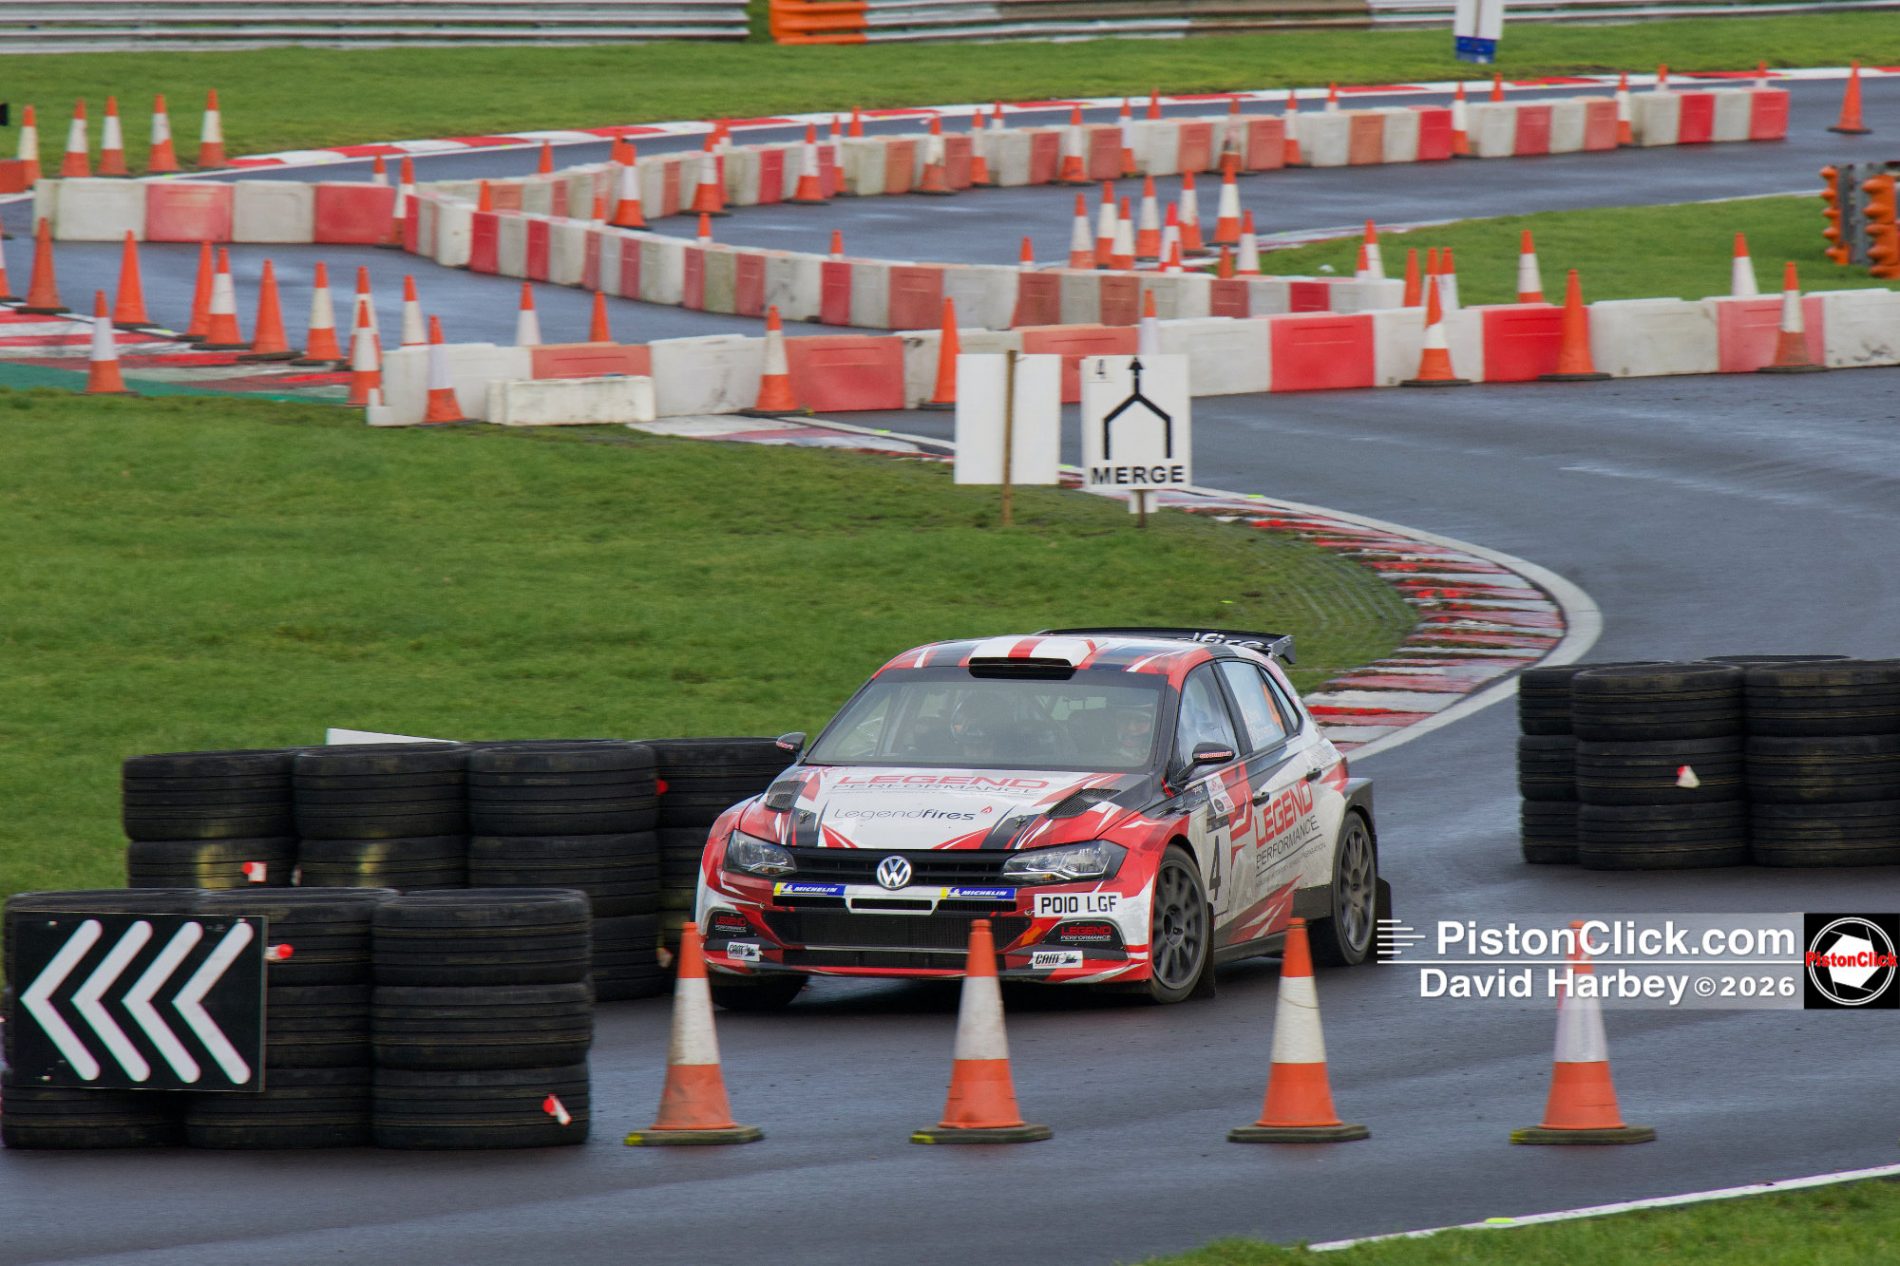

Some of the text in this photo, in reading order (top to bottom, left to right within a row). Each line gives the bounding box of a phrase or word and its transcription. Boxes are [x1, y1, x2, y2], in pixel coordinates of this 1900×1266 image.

[1092, 465, 1184, 485] MERGE
[831, 784, 1042, 794] PERFORMANCE
[837, 775, 1050, 789] LEGEND
[834, 808, 976, 821] Legendfires
[1254, 782, 1314, 849] LEGEND
[1256, 815, 1320, 869] PERFORMANCE
[1209, 835, 1222, 901] 4
[1087, 895, 1117, 913] LGF
[1061, 926, 1113, 935] LEGEND
